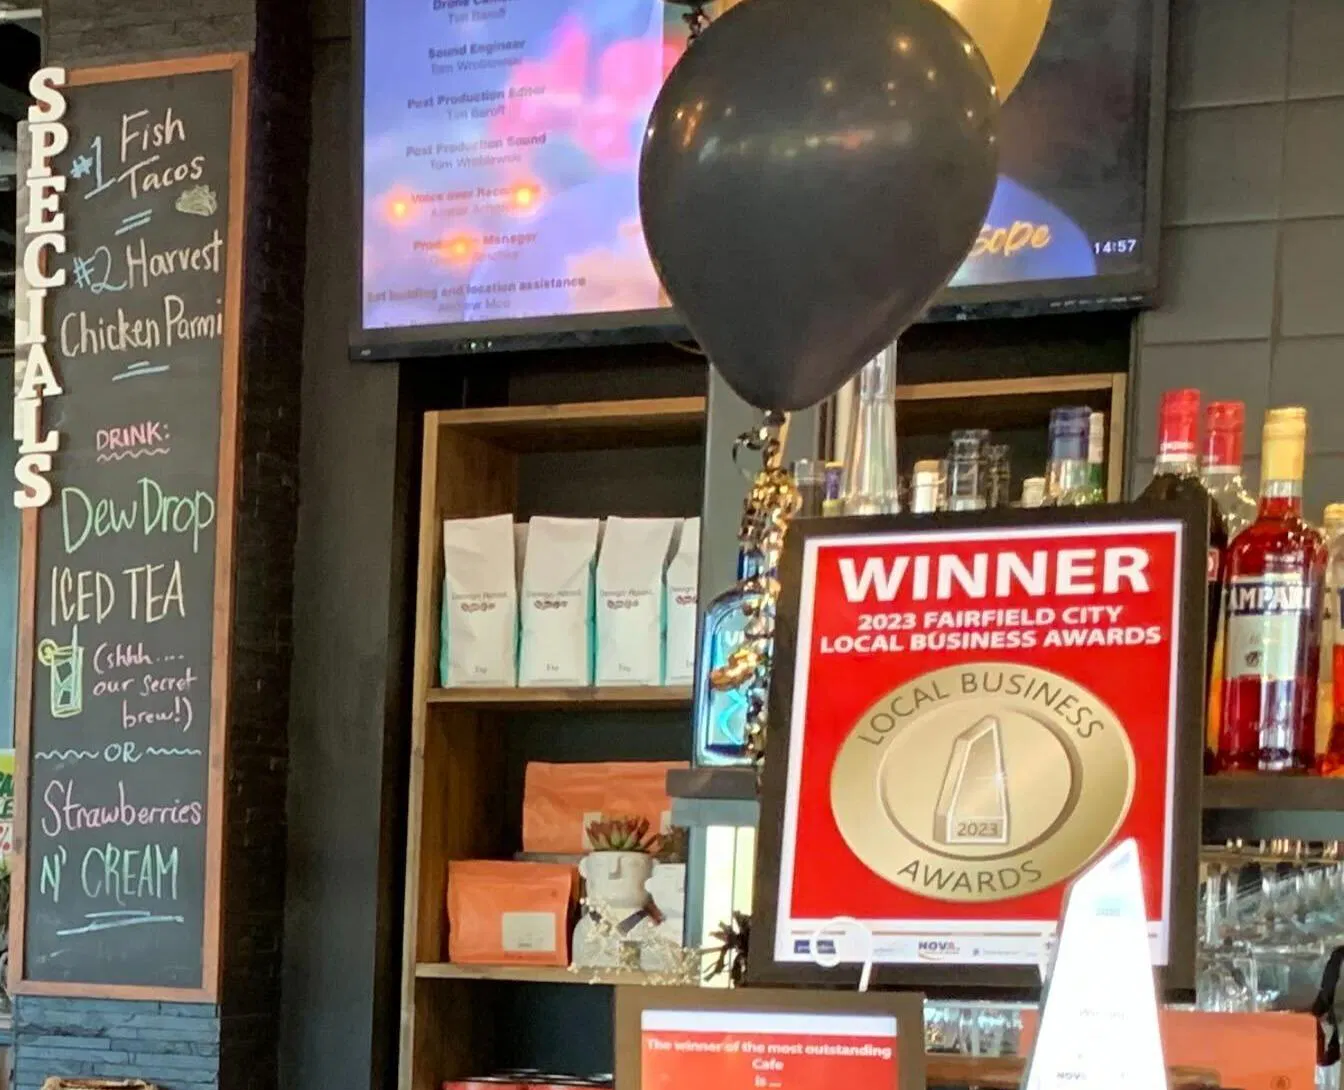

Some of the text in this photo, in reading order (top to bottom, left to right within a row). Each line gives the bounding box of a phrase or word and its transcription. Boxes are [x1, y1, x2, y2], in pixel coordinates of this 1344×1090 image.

[70, 106, 187, 200] #1 Fish
[116, 154, 207, 200] Tacos
[72, 229, 224, 294] #2 Harvest
[1094, 239, 1137, 255] 14:57
[14, 67, 69, 509] SPECIALS
[60, 294, 224, 358] Chicken Parmi
[96, 420, 171, 453] DRINK:
[62, 477, 215, 554] Dew Drop
[50, 559, 186, 627] ICED TEA
[838, 547, 1151, 603] WINNER
[1223, 585, 1312, 612] AMPARI
[857, 604, 1124, 632] 2023 FAIRFIELD CITY
[820, 625, 1163, 655] LOCAL BUSINESS AWARDS
[93, 679, 135, 697] our
[122, 696, 194, 733] brew!)
[857, 670, 1106, 747] LOCAL BUSINESS
[104, 741, 144, 764] OR
[41, 778, 203, 837] Strawberries
[957, 822, 1000, 838] 2023
[81, 842, 180, 907] CREAM
[896, 858, 1043, 894] AWARDS
[647, 1038, 893, 1060] The winner of the most outstanding
[752, 1058, 785, 1072] Cafe
